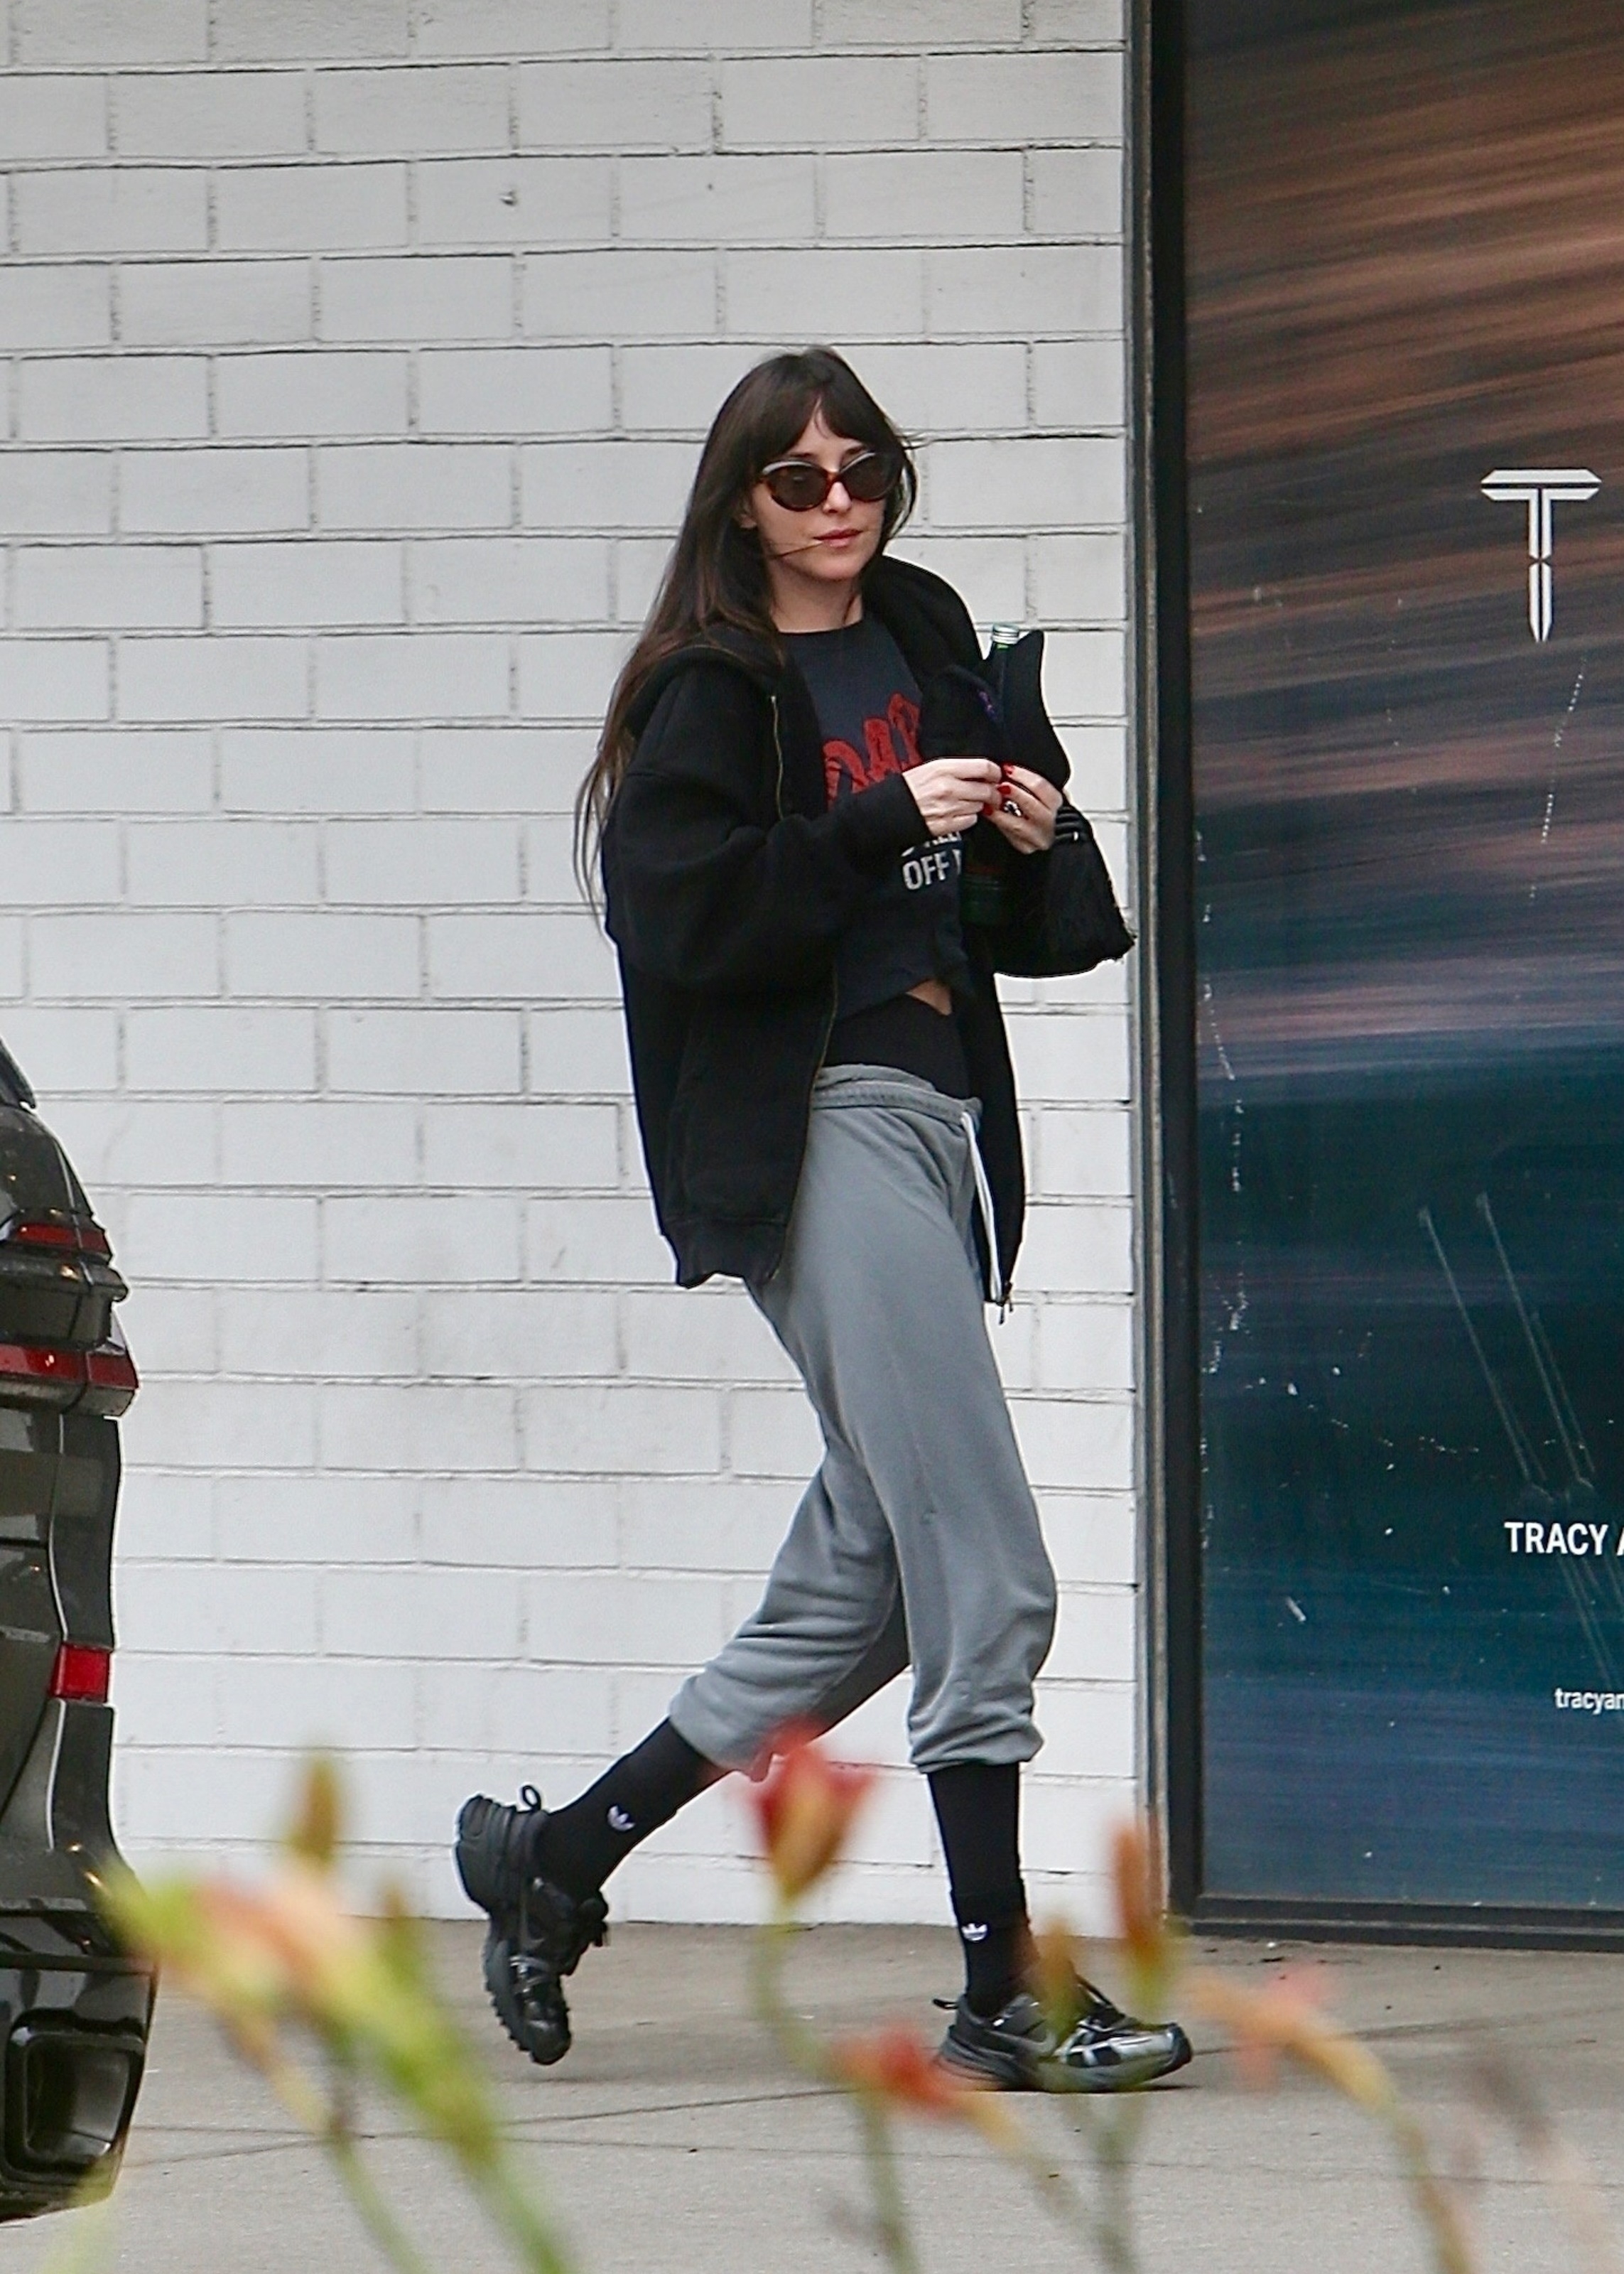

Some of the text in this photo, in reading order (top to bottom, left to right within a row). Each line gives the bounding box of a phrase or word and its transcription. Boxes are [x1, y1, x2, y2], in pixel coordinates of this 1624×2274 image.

[1480, 469, 1601, 642] T
[902, 851, 950, 890] OFF
[1504, 1521, 1608, 1555] TRACY
